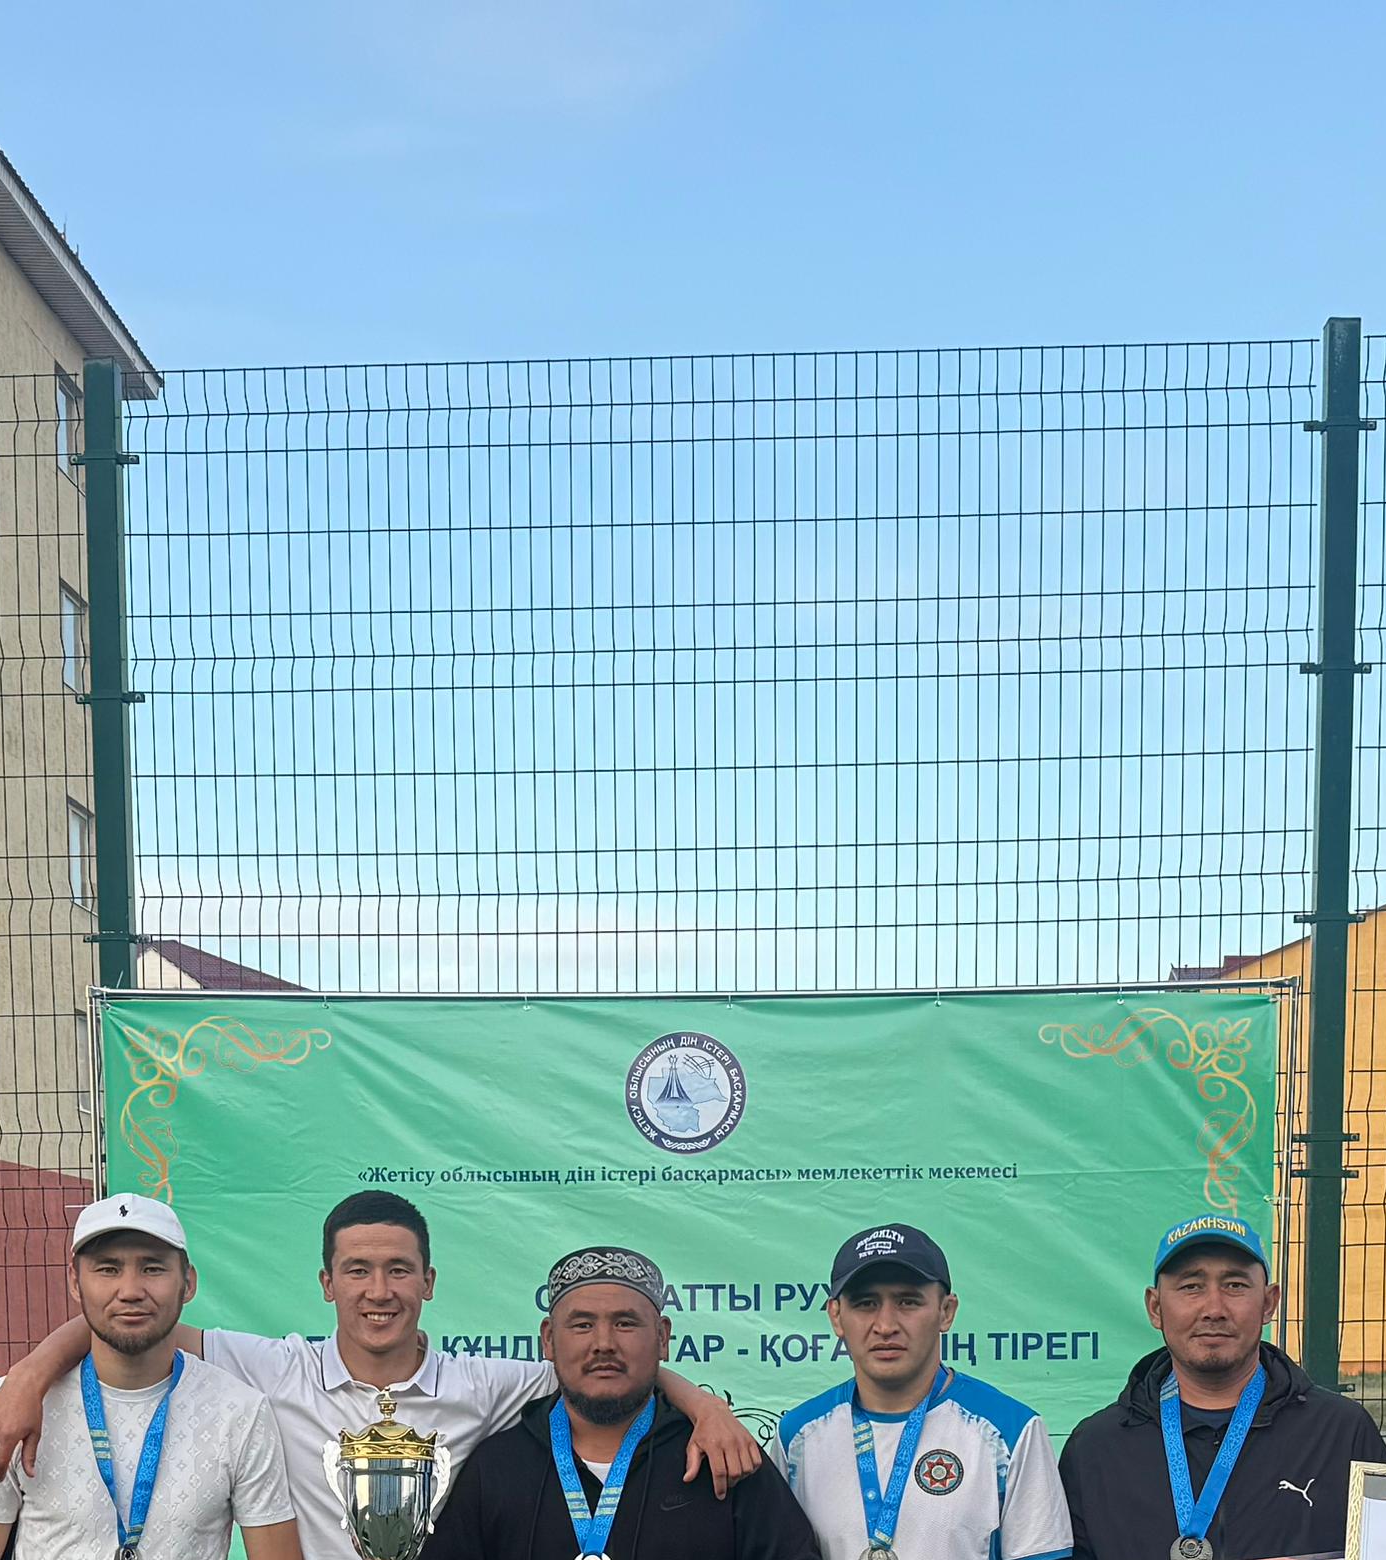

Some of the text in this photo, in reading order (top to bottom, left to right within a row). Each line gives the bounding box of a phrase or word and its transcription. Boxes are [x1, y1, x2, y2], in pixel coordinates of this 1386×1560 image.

[680, 1036, 697, 1046] ДІН
[357, 1163, 1018, 1187] «Жетісу облысының дін істері басқармасы» мемлекеттік мекемесі
[1167, 1216, 1246, 1245] KAZAKHSTAN
[987, 1332, 1099, 1361] ТІРЕГІ
